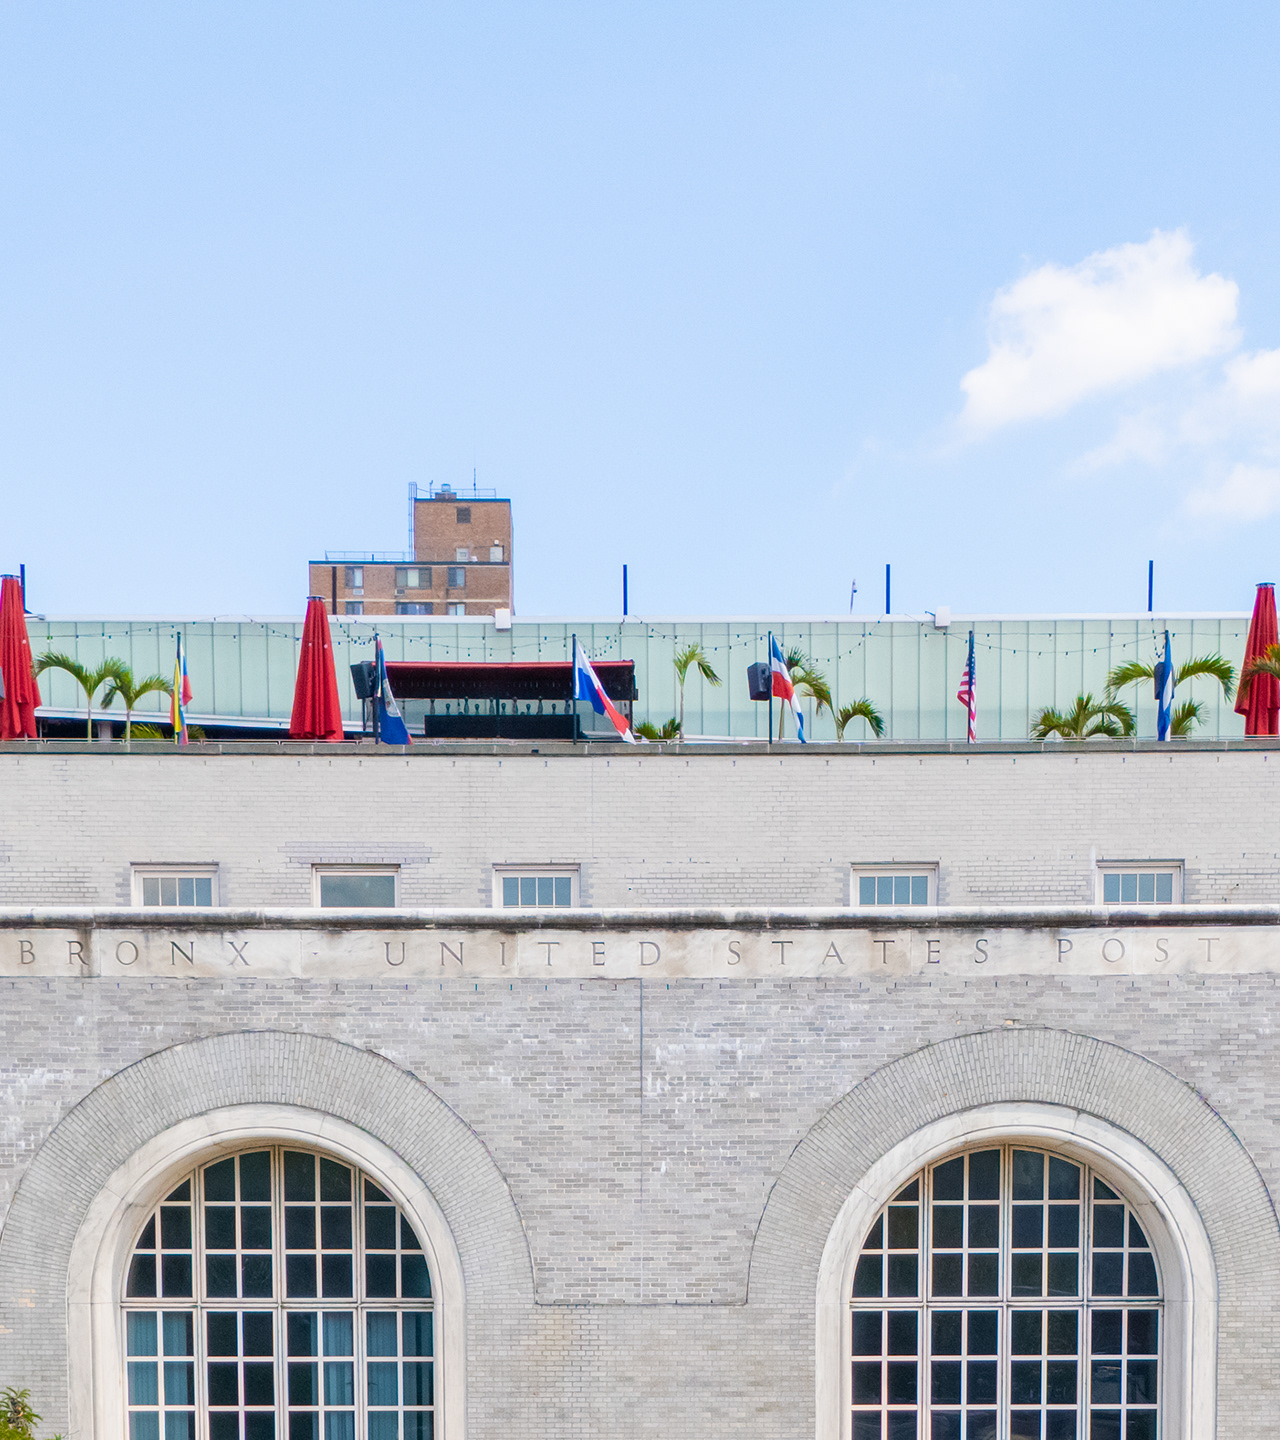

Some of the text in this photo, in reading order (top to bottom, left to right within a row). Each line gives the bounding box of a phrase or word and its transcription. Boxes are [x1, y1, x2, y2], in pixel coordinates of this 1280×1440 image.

[17, 939, 252, 967] BRONX
[384, 939, 662, 967] UNITED
[726, 938, 990, 967] STATES
[1055, 937, 1221, 965] POST
